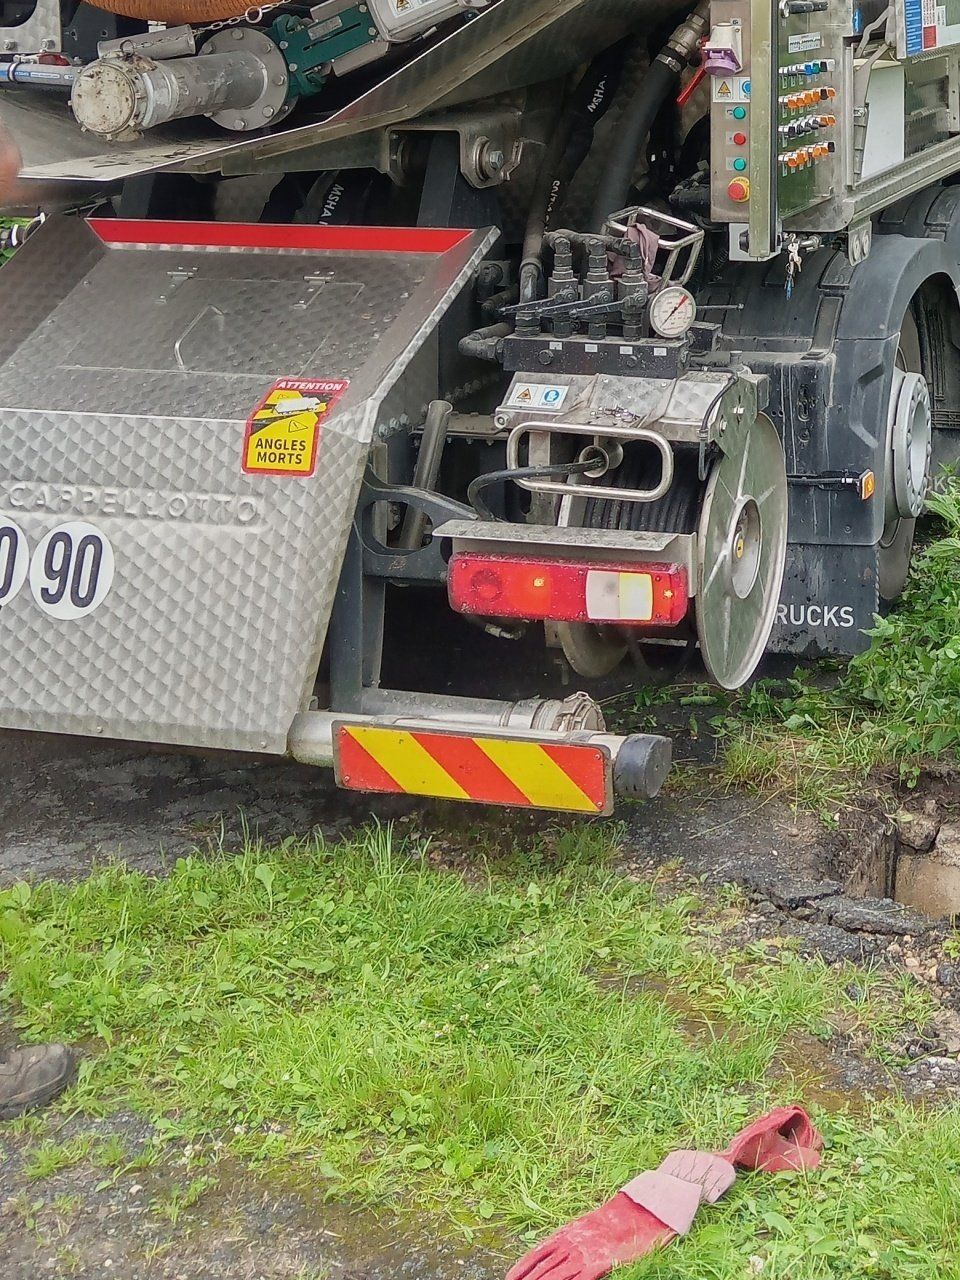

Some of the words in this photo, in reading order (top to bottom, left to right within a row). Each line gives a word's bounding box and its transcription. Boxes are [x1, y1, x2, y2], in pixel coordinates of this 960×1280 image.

[586, 80, 606, 113] MSHA
[320, 183, 345, 217] MSHA
[278, 381, 344, 391] ATTENTION
[255, 438, 306, 451] ANGLES
[256, 451, 303, 465] MORTS
[9, 483, 257, 522] CAPPELLOTTO
[40, 531, 103, 608] 90
